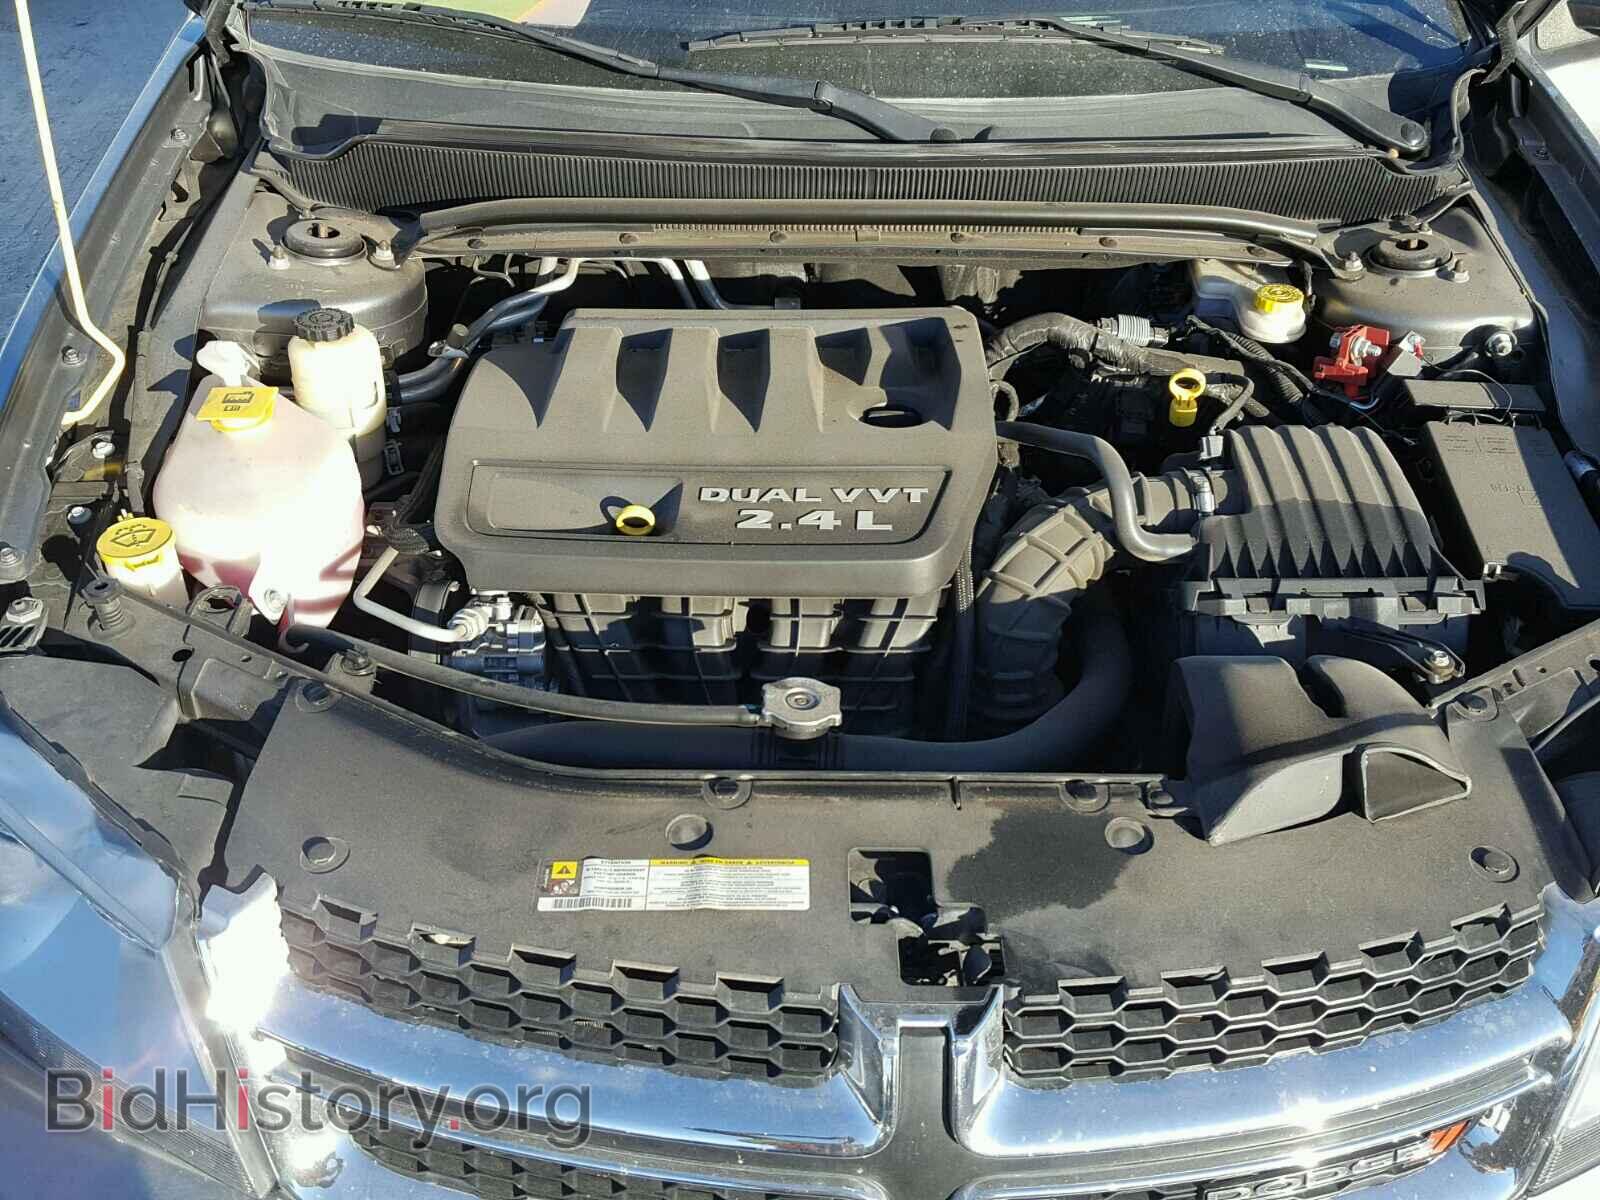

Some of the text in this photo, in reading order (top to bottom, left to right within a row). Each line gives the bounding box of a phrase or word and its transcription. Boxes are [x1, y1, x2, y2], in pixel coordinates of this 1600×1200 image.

[699, 487, 929, 503] DUAL VVT
[736, 509, 893, 531] 2.4 L
